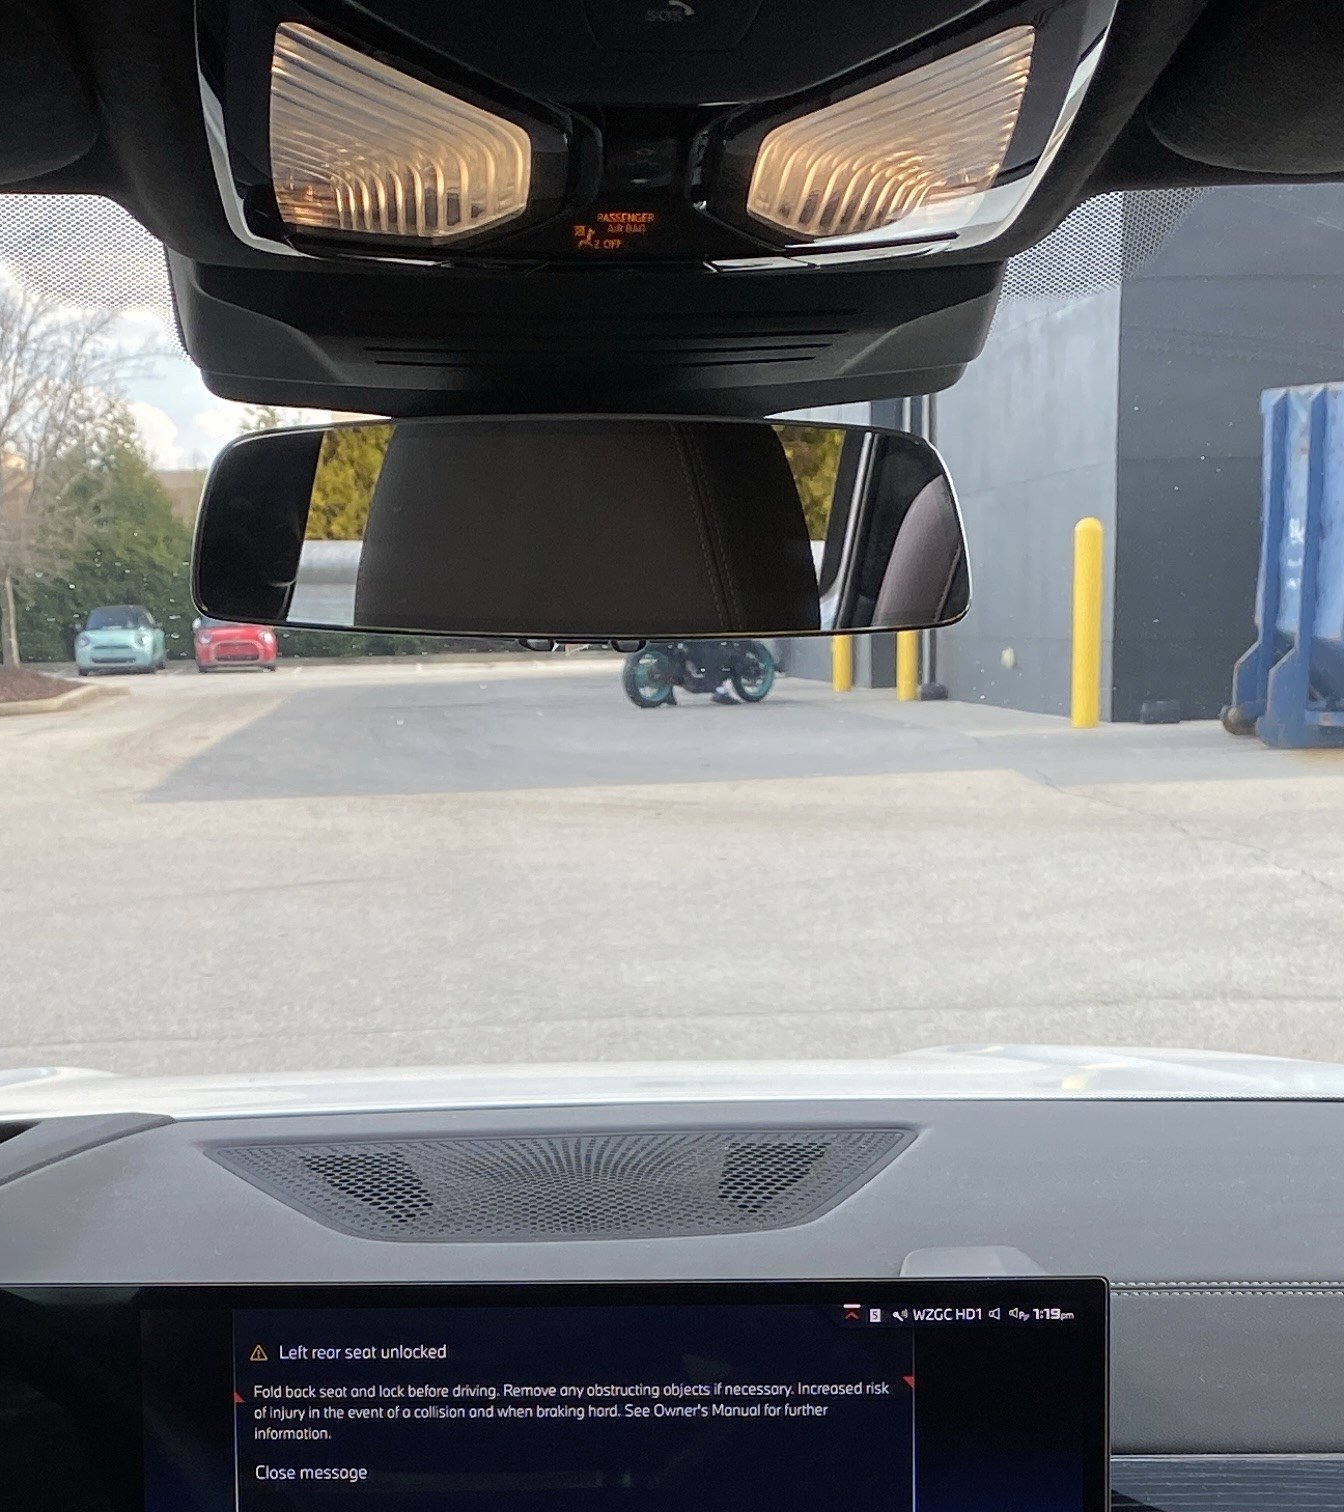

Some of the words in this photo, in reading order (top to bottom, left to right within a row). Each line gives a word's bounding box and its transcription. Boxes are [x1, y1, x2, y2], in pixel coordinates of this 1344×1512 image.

[597, 213, 654, 222] PASSENGER
[913, 1308, 953, 1321] WZGC
[956, 1308, 982, 1320] HD1
[279, 1344, 308, 1359] Left
[312, 1348, 341, 1359] rear
[345, 1346, 377, 1359] seat
[381, 1344, 447, 1359] unlocked
[254, 1385, 282, 1398] Fold
[286, 1385, 316, 1398] back
[319, 1387, 347, 1398] seat
[351, 1385, 376, 1398] and
[379, 1385, 405, 1397] lock
[408, 1384, 449, 1397] before
[453, 1384, 501, 1400] driving.
[504, 1384, 556, 1397] Remove
[560, 1386, 584, 1400] any
[587, 1383, 659, 1399] obstructing
[663, 1383, 710, 1398] objects
[714, 1382, 722, 1395] if
[725, 1384, 794, 1398] necessary.
[798, 1382, 862, 1395] Increased
[866, 1382, 889, 1395] risk
[254, 1406, 267, 1419] of
[270, 1406, 305, 1421] injury
[309, 1406, 320, 1418] in
[324, 1406, 344, 1419] the
[348, 1407, 383, 1419] event
[387, 1405, 400, 1418] of
[414, 1405, 465, 1418] collision
[469, 1405, 494, 1418] and
[497, 1405, 533, 1418] when
[537, 1405, 584, 1420] braking
[588, 1404, 621, 1417] hard.
[625, 1404, 650, 1417] See
[654, 1404, 708, 1417] Owner's
[712, 1404, 761, 1416] Manual
[764, 1403, 782, 1416] for
[785, 1403, 828, 1416] further
[254, 1427, 332, 1440] information.
[256, 1465, 296, 1480] Close
[300, 1468, 368, 1482] message
